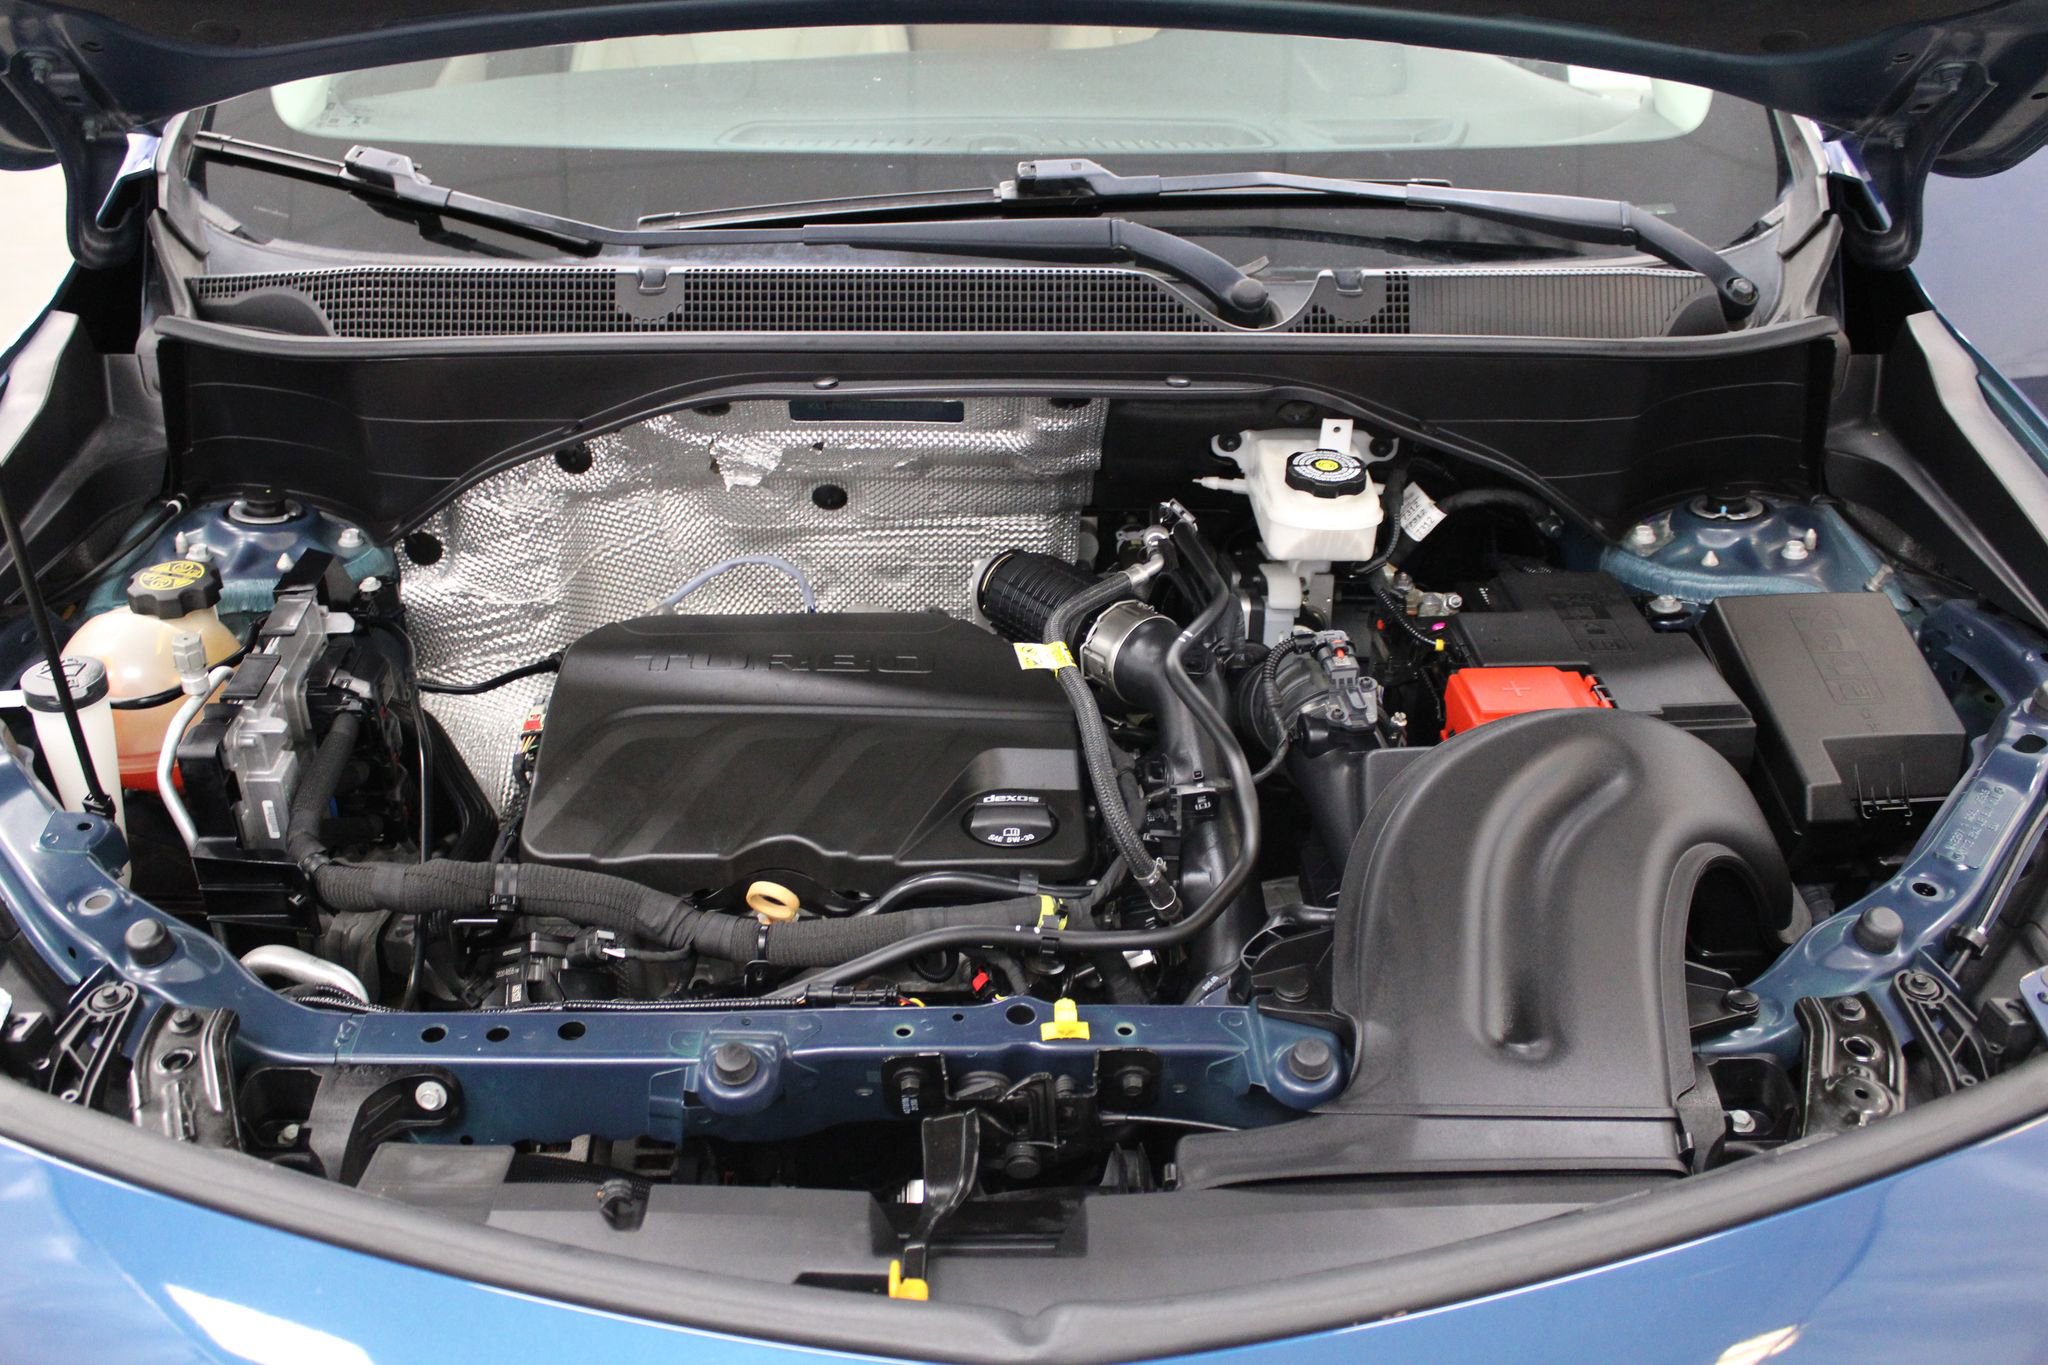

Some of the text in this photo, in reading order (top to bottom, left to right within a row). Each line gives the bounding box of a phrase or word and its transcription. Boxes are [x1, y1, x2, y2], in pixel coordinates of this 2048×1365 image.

[1402, 500, 1422, 520] 7312
[633, 654, 936, 673] TURBO
[983, 794, 1040, 803] dexos
